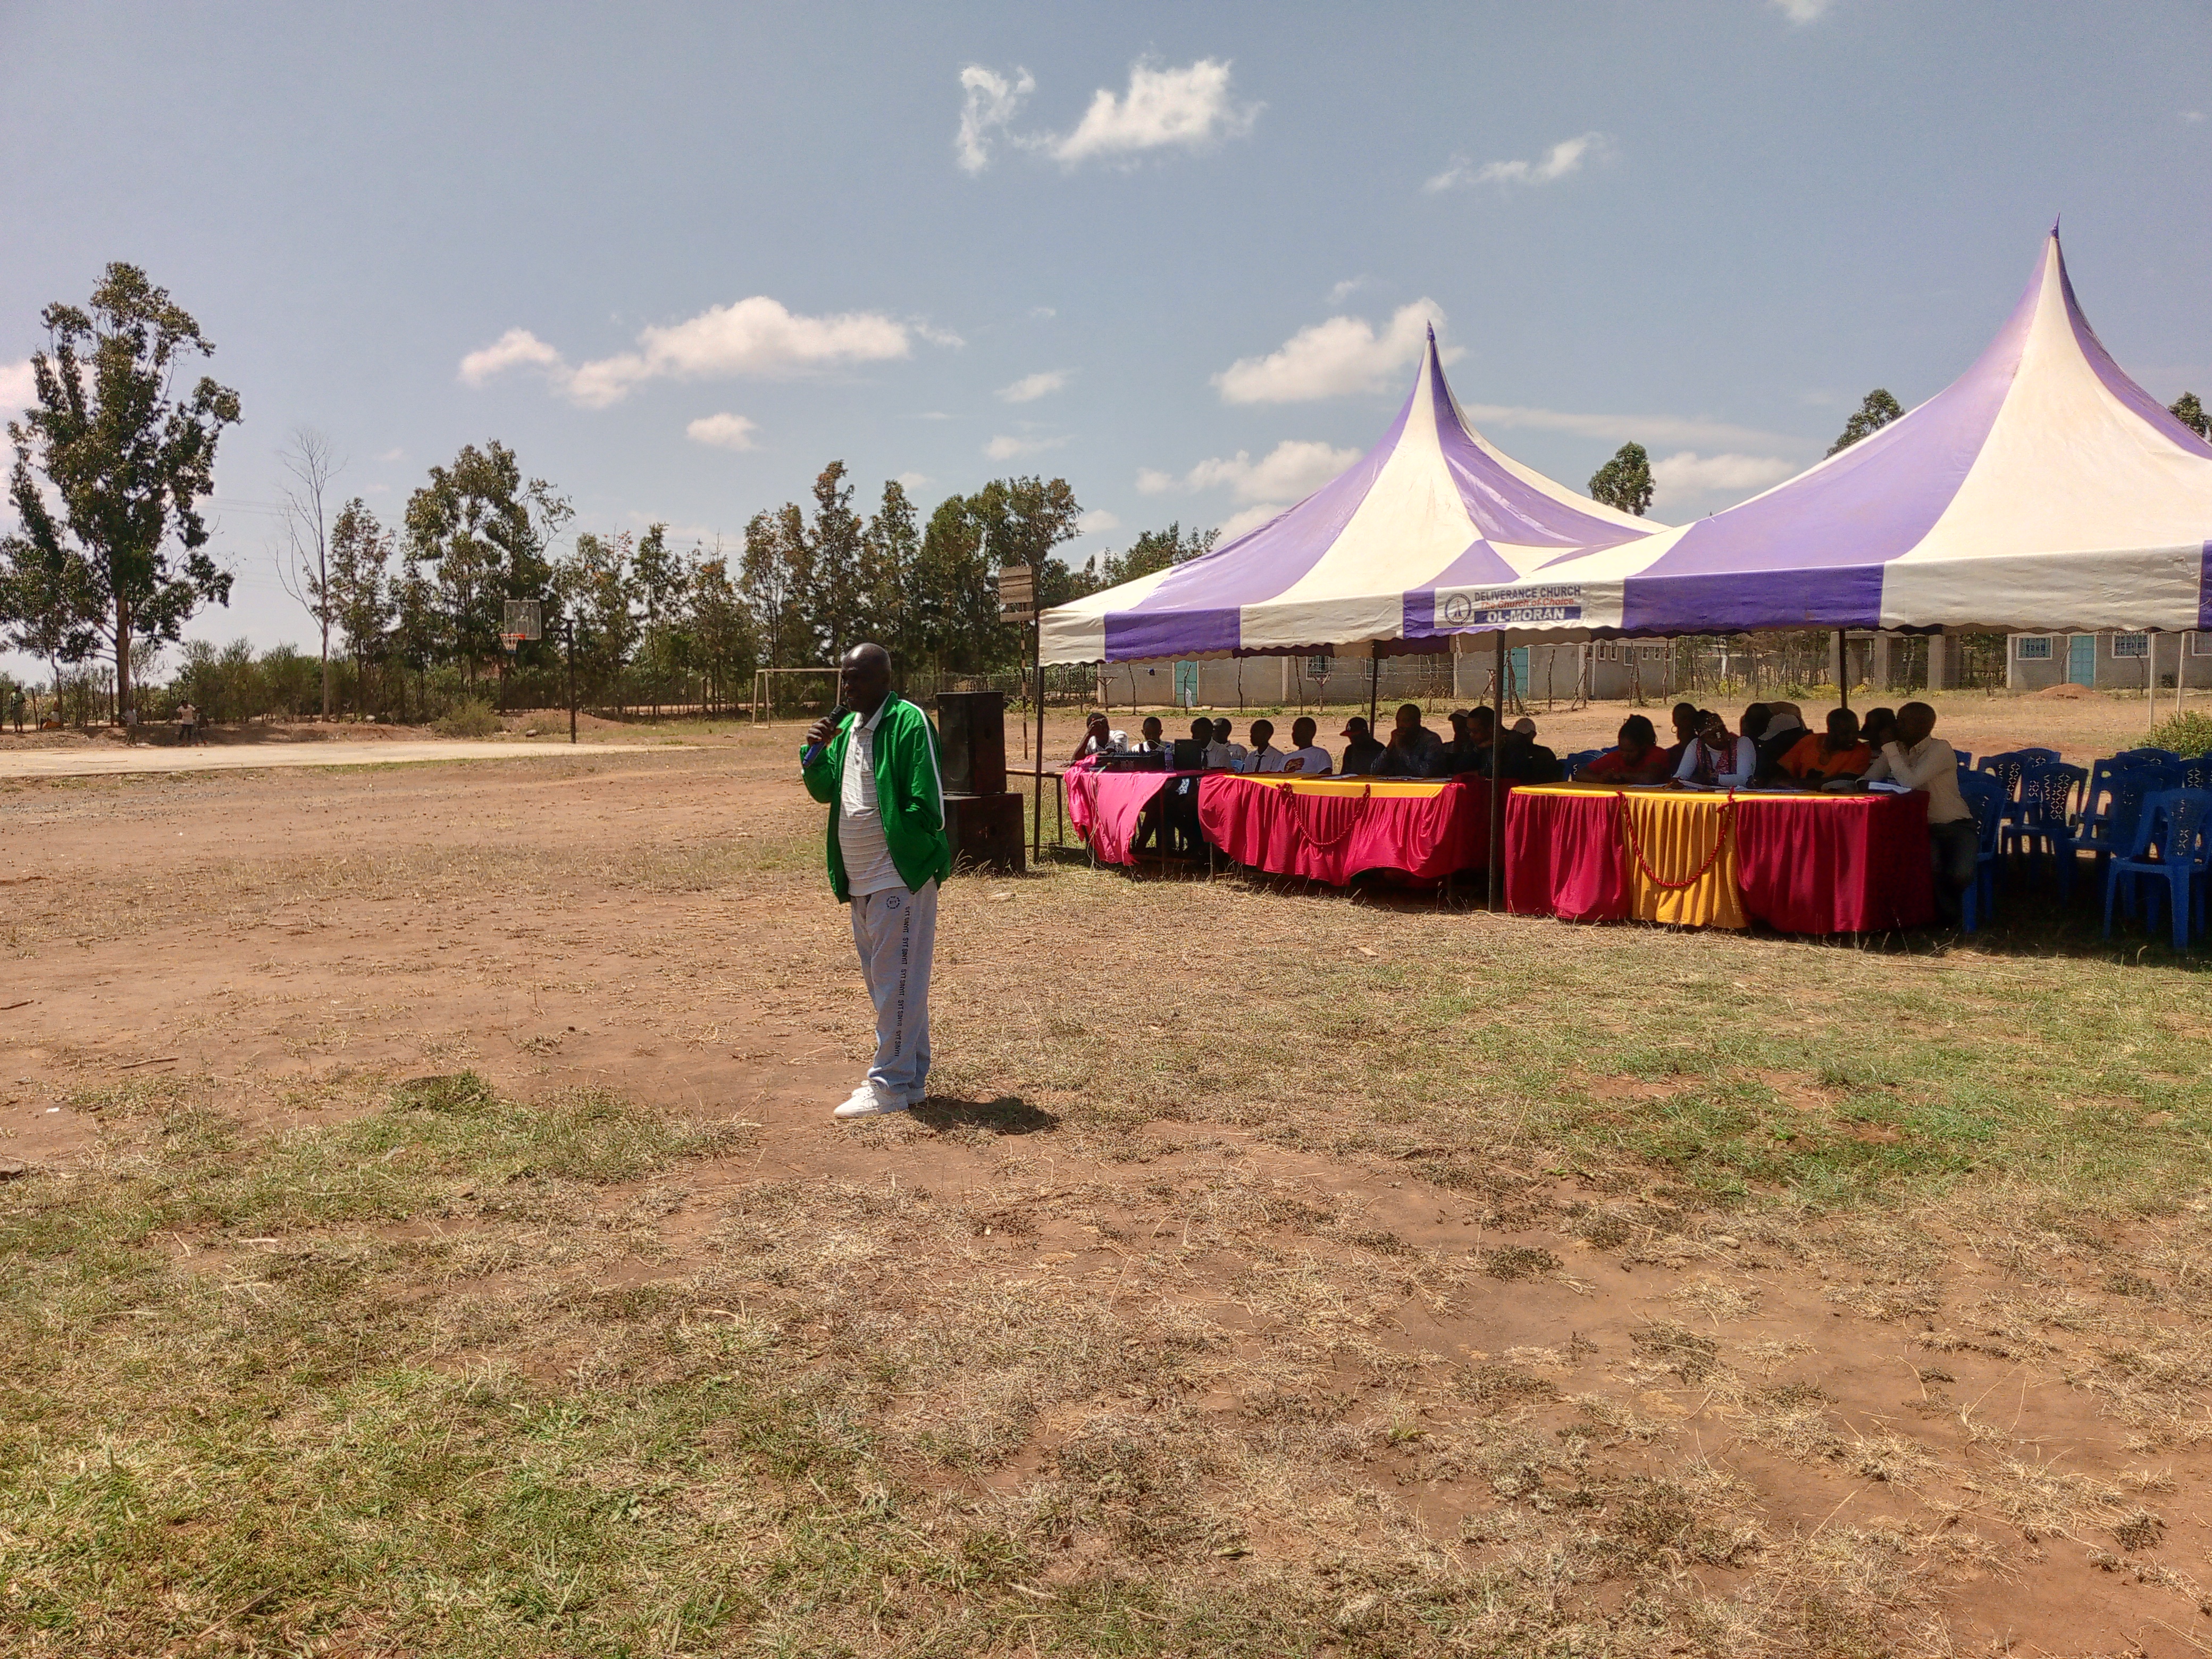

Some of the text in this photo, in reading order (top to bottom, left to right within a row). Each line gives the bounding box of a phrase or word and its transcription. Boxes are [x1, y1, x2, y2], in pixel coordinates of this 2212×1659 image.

[1474, 585, 1581, 601] DELIVERANCE CHURCH
[1481, 597, 1574, 610] The Church of Choice
[1487, 608, 1565, 623] OL-MORAN
